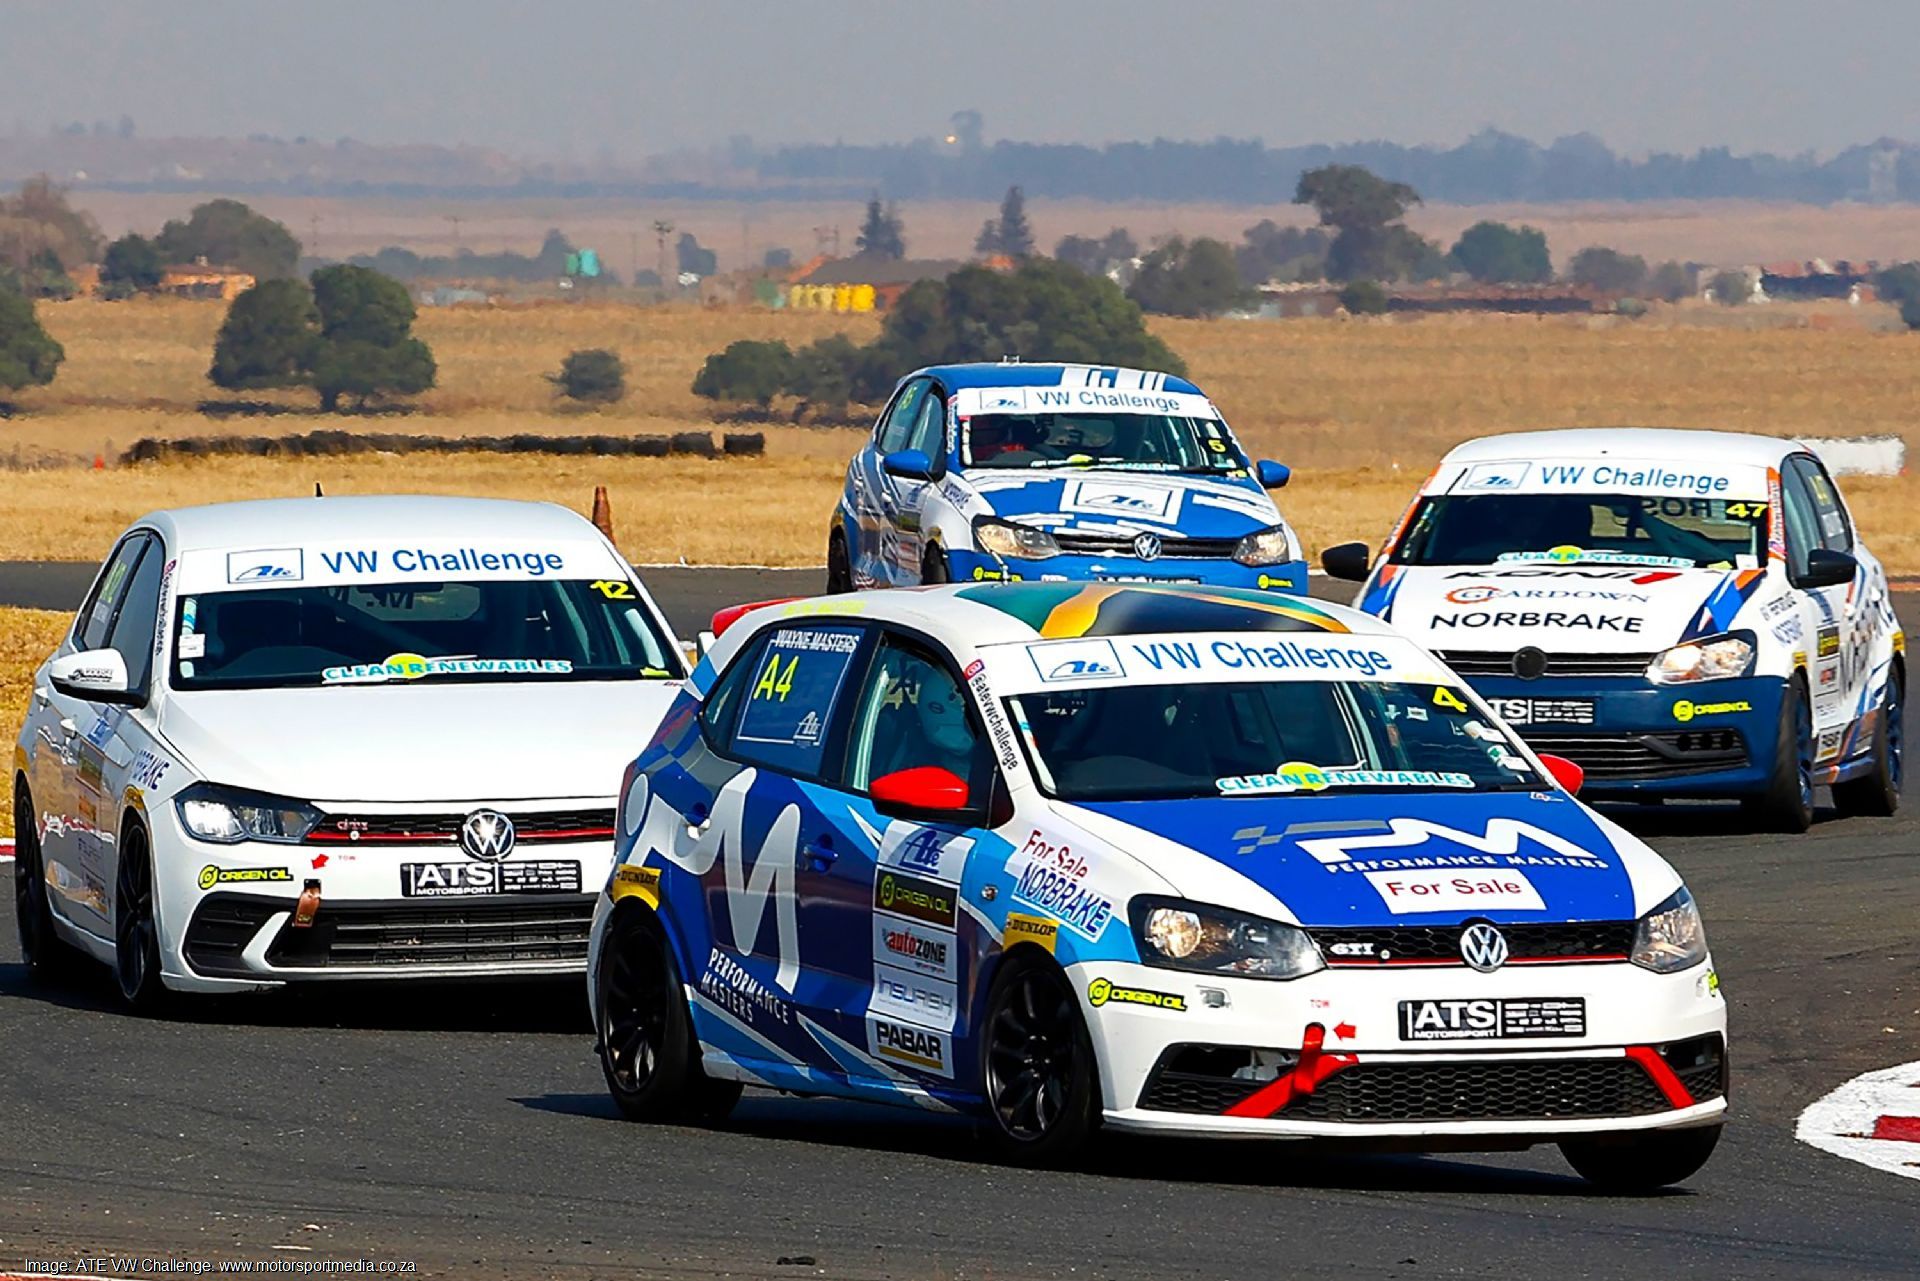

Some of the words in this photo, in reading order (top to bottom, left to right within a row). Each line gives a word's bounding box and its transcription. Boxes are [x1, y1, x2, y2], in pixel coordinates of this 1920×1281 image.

[1037, 391, 1071, 405] VW
[1079, 391, 1180, 411] Challenge
[1207, 439, 1226, 452] 5
[1541, 466, 1585, 485] VW
[1593, 466, 1729, 494] Challenge
[1726, 502, 1769, 518] 47
[320, 550, 378, 574] VW
[392, 548, 564, 575] Challenge
[1498, 552, 1562, 562] CLEAN
[1566, 552, 1695, 567] RENEWABLES
[590, 579, 636, 599] 12
[1460, 588, 1651, 603] GEARDOWN
[1430, 612, 1645, 634] NORBRAKE
[775, 629, 814, 650] WAYNE
[809, 631, 860, 653] MASTERS
[1132, 641, 1202, 670] VW
[1211, 640, 1393, 676] Challenge
[325, 662, 405, 681] CLEAN
[409, 659, 572, 674] RENEWABLES
[753, 653, 800, 703] A4
[1432, 686, 1468, 713] 4
[1487, 699, 1528, 718] TS
[1219, 772, 1301, 791] CLEAN
[1306, 769, 1474, 787] RENEWABLES
[1021, 829, 1056, 860] For
[1057, 845, 1088, 878] Sale
[1324, 854, 1499, 874] PERFORMANCE
[1505, 854, 1610, 869] MASTERS
[218, 870, 268, 881] ORIGEN
[269, 869, 291, 880] OIL
[417, 863, 494, 886] ATS
[416, 886, 494, 896] MOTORSPORT
[1018, 861, 1112, 934] NORBRAKE
[1385, 882, 1451, 897] For
[1458, 878, 1522, 895] Sale
[1011, 919, 1057, 937] DUNLOP
[1330, 942, 1375, 956] GTI
[700, 970, 753, 1023] MASTERS
[707, 946, 789, 1025] PERFORMANCE
[1110, 987, 1162, 1006] ORIGEN
[1163, 997, 1188, 1010] OIL
[1414, 1001, 1496, 1028] ATS
[875, 1020, 942, 1061] PABAR
[1414, 1029, 1496, 1039] MOTORSPORT
